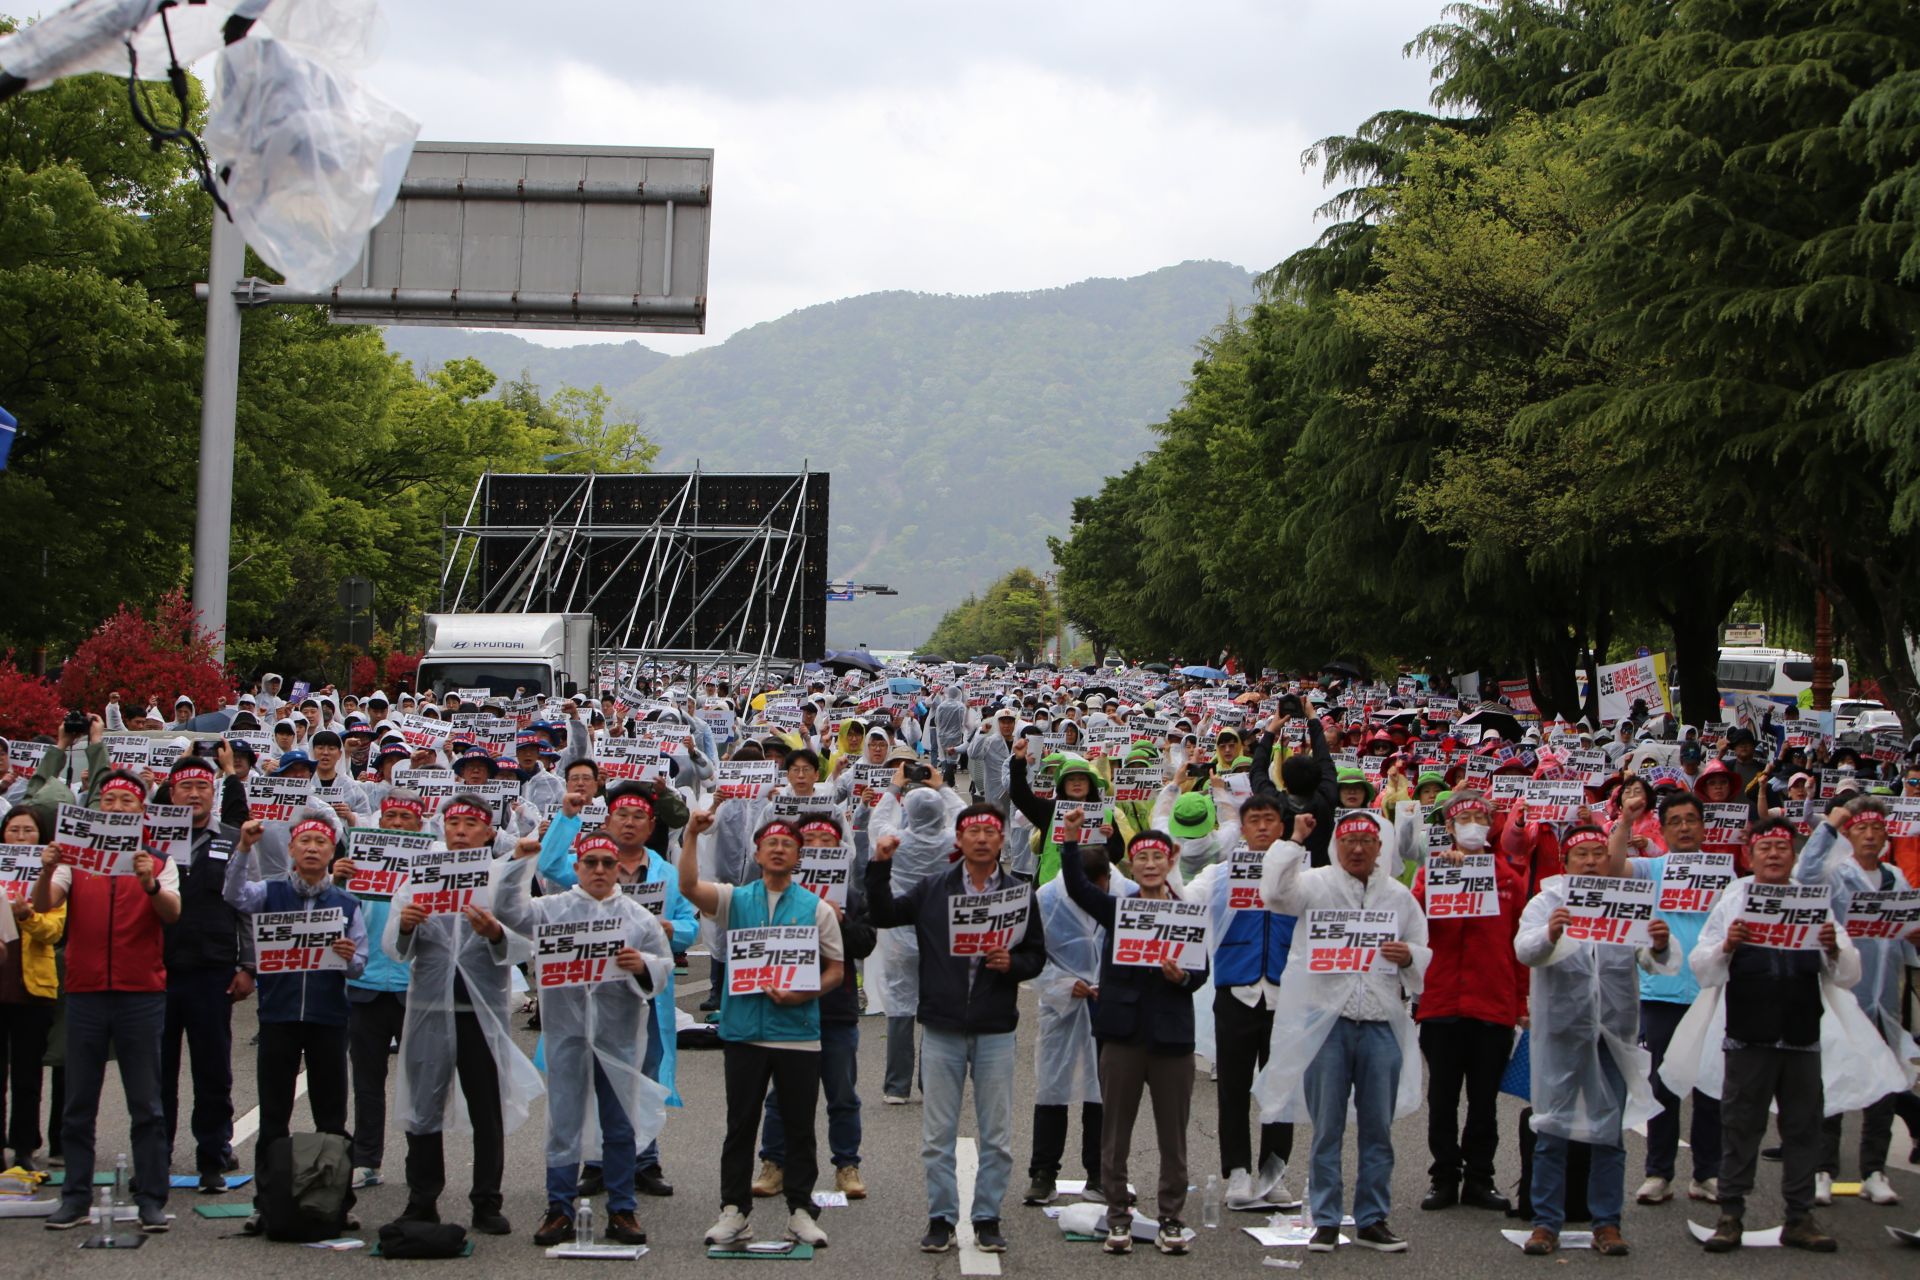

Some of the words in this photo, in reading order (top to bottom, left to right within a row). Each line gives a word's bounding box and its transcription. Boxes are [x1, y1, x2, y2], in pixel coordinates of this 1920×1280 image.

[406, 714, 433, 723] 내란세력
[605, 739, 637, 747] 내란세력
[639, 740, 659, 748] 청산!
[660, 742, 677, 753] 취!
[603, 747, 659, 765] 노동기본권
[394, 770, 429, 779] 내란세력
[431, 770, 451, 779] 청산!
[604, 762, 645, 779] 쟁취!
[719, 770, 772, 784] 노동기본권
[251, 777, 285, 786] 내란세력
[286, 778, 308, 787] 청산!
[250, 787, 308, 805] 노동기본권
[720, 785, 760, 799] 쟁취!
[775, 797, 808, 805] 내란세력
[811, 796, 832, 804] 청산!
[1527, 790, 1581, 805] 노동기본권
[62, 805, 108, 824] 내란세력
[109, 815, 139, 825] 청산!
[161, 807, 190, 817] 청산!
[251, 804, 295, 821] 쟁취!
[1526, 805, 1568, 821] 쟁취!
[1727, 804, 1747, 813] 청산!
[1703, 812, 1745, 829] 동기본권
[59, 819, 139, 851] 노동기본권
[354, 834, 400, 846] 내란세력
[403, 838, 431, 850] 청산!
[59, 843, 118, 874] 쟁취!
[352, 846, 408, 872] 노동기본
[412, 853, 455, 866] 내란세력
[458, 850, 488, 863] 청산!
[820, 849, 847, 859] 청산!
[1477, 856, 1493, 866] 청산!
[1667, 855, 1702, 865] 내란세력
[1705, 856, 1731, 866] 청산!
[411, 867, 488, 891] 노동기본권
[1428, 870, 1494, 893] 노동기본권
[1569, 877, 1621, 891] 내란세력
[1622, 880, 1654, 893] 청산!
[638, 882, 664, 894] 청산!
[1748, 885, 1799, 898] 내란세력
[1802, 887, 1828, 898] 청산!
[1852, 892, 1897, 901] 내란세력
[413, 889, 473, 915] 쟁취!
[953, 893, 1003, 908] 내란세력
[1005, 886, 1029, 901] 청산!
[1429, 893, 1483, 915] 쟁취!
[1566, 891, 1652, 920] 노동기본권
[1659, 889, 1714, 912] 쟁취!
[1120, 900, 1173, 913] 내란세력
[1175, 904, 1207, 916] 청산!
[1745, 898, 1828, 924] 노동기본권
[257, 912, 306, 925] 내란세력
[310, 909, 340, 923] 청산!
[952, 907, 1028, 932] 노동기본권
[1311, 911, 1361, 922] 내란세력
[1364, 912, 1394, 923] 청산!
[538, 923, 589, 937] 내란세력
[592, 918, 622, 932] 청산!
[732, 930, 781, 943] 내란세력
[784, 928, 815, 939] 청산!
[1118, 913, 1206, 942] 노동기본권
[1566, 916, 1632, 944] 쟁취!
[1745, 922, 1809, 948] 쟁취!
[538, 937, 625, 960] 노동기본권
[731, 943, 815, 965] 노동기본권
[1116, 939, 1185, 964] 쟁취!
[259, 948, 324, 971] 쟁취!
[1310, 948, 1376, 972] 쟁취!
[541, 959, 608, 986] 쟁취!
[732, 966, 797, 992] 쟁취!
